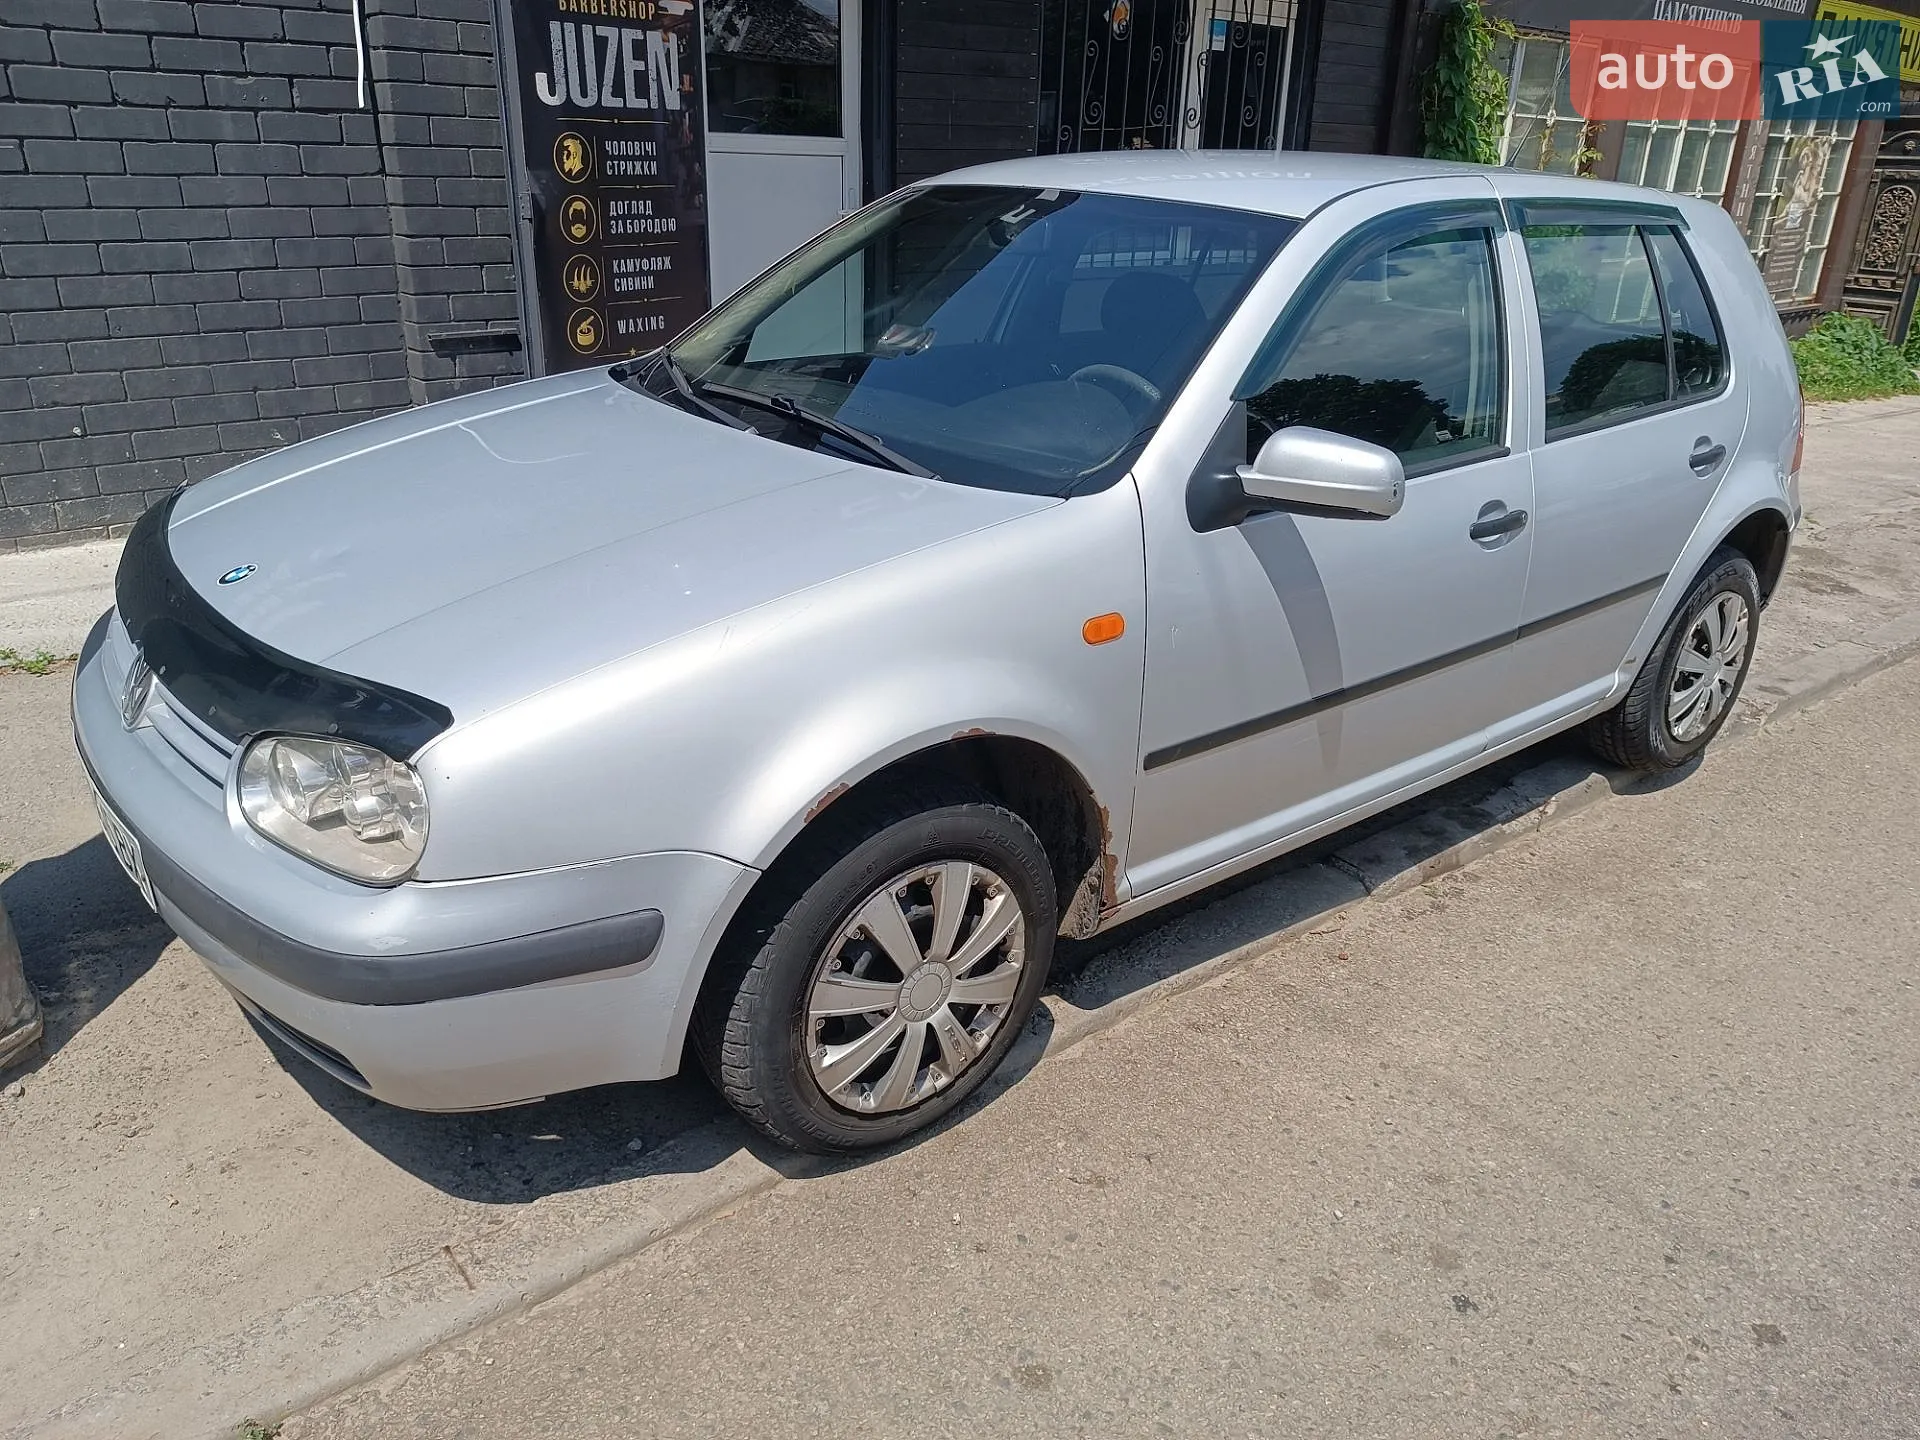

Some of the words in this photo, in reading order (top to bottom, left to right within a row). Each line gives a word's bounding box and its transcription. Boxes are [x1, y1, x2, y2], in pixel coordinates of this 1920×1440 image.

[559, 0, 656, 21] BARBERSHOP
[535, 20, 681, 110] JUZEN
[605, 140, 657, 156] ЧОЛОВІЧІ
[606, 160, 658, 176] СТРИЖКИ
[609, 200, 653, 216] ДОГЛЯД
[610, 220, 624, 235] ЗА
[627, 218, 677, 234] БОРОДОЮ
[613, 255, 672, 273] КАМУФЛЯЖ
[614, 276, 655, 292] СИВИНИ
[617, 315, 665, 335] WAXING
